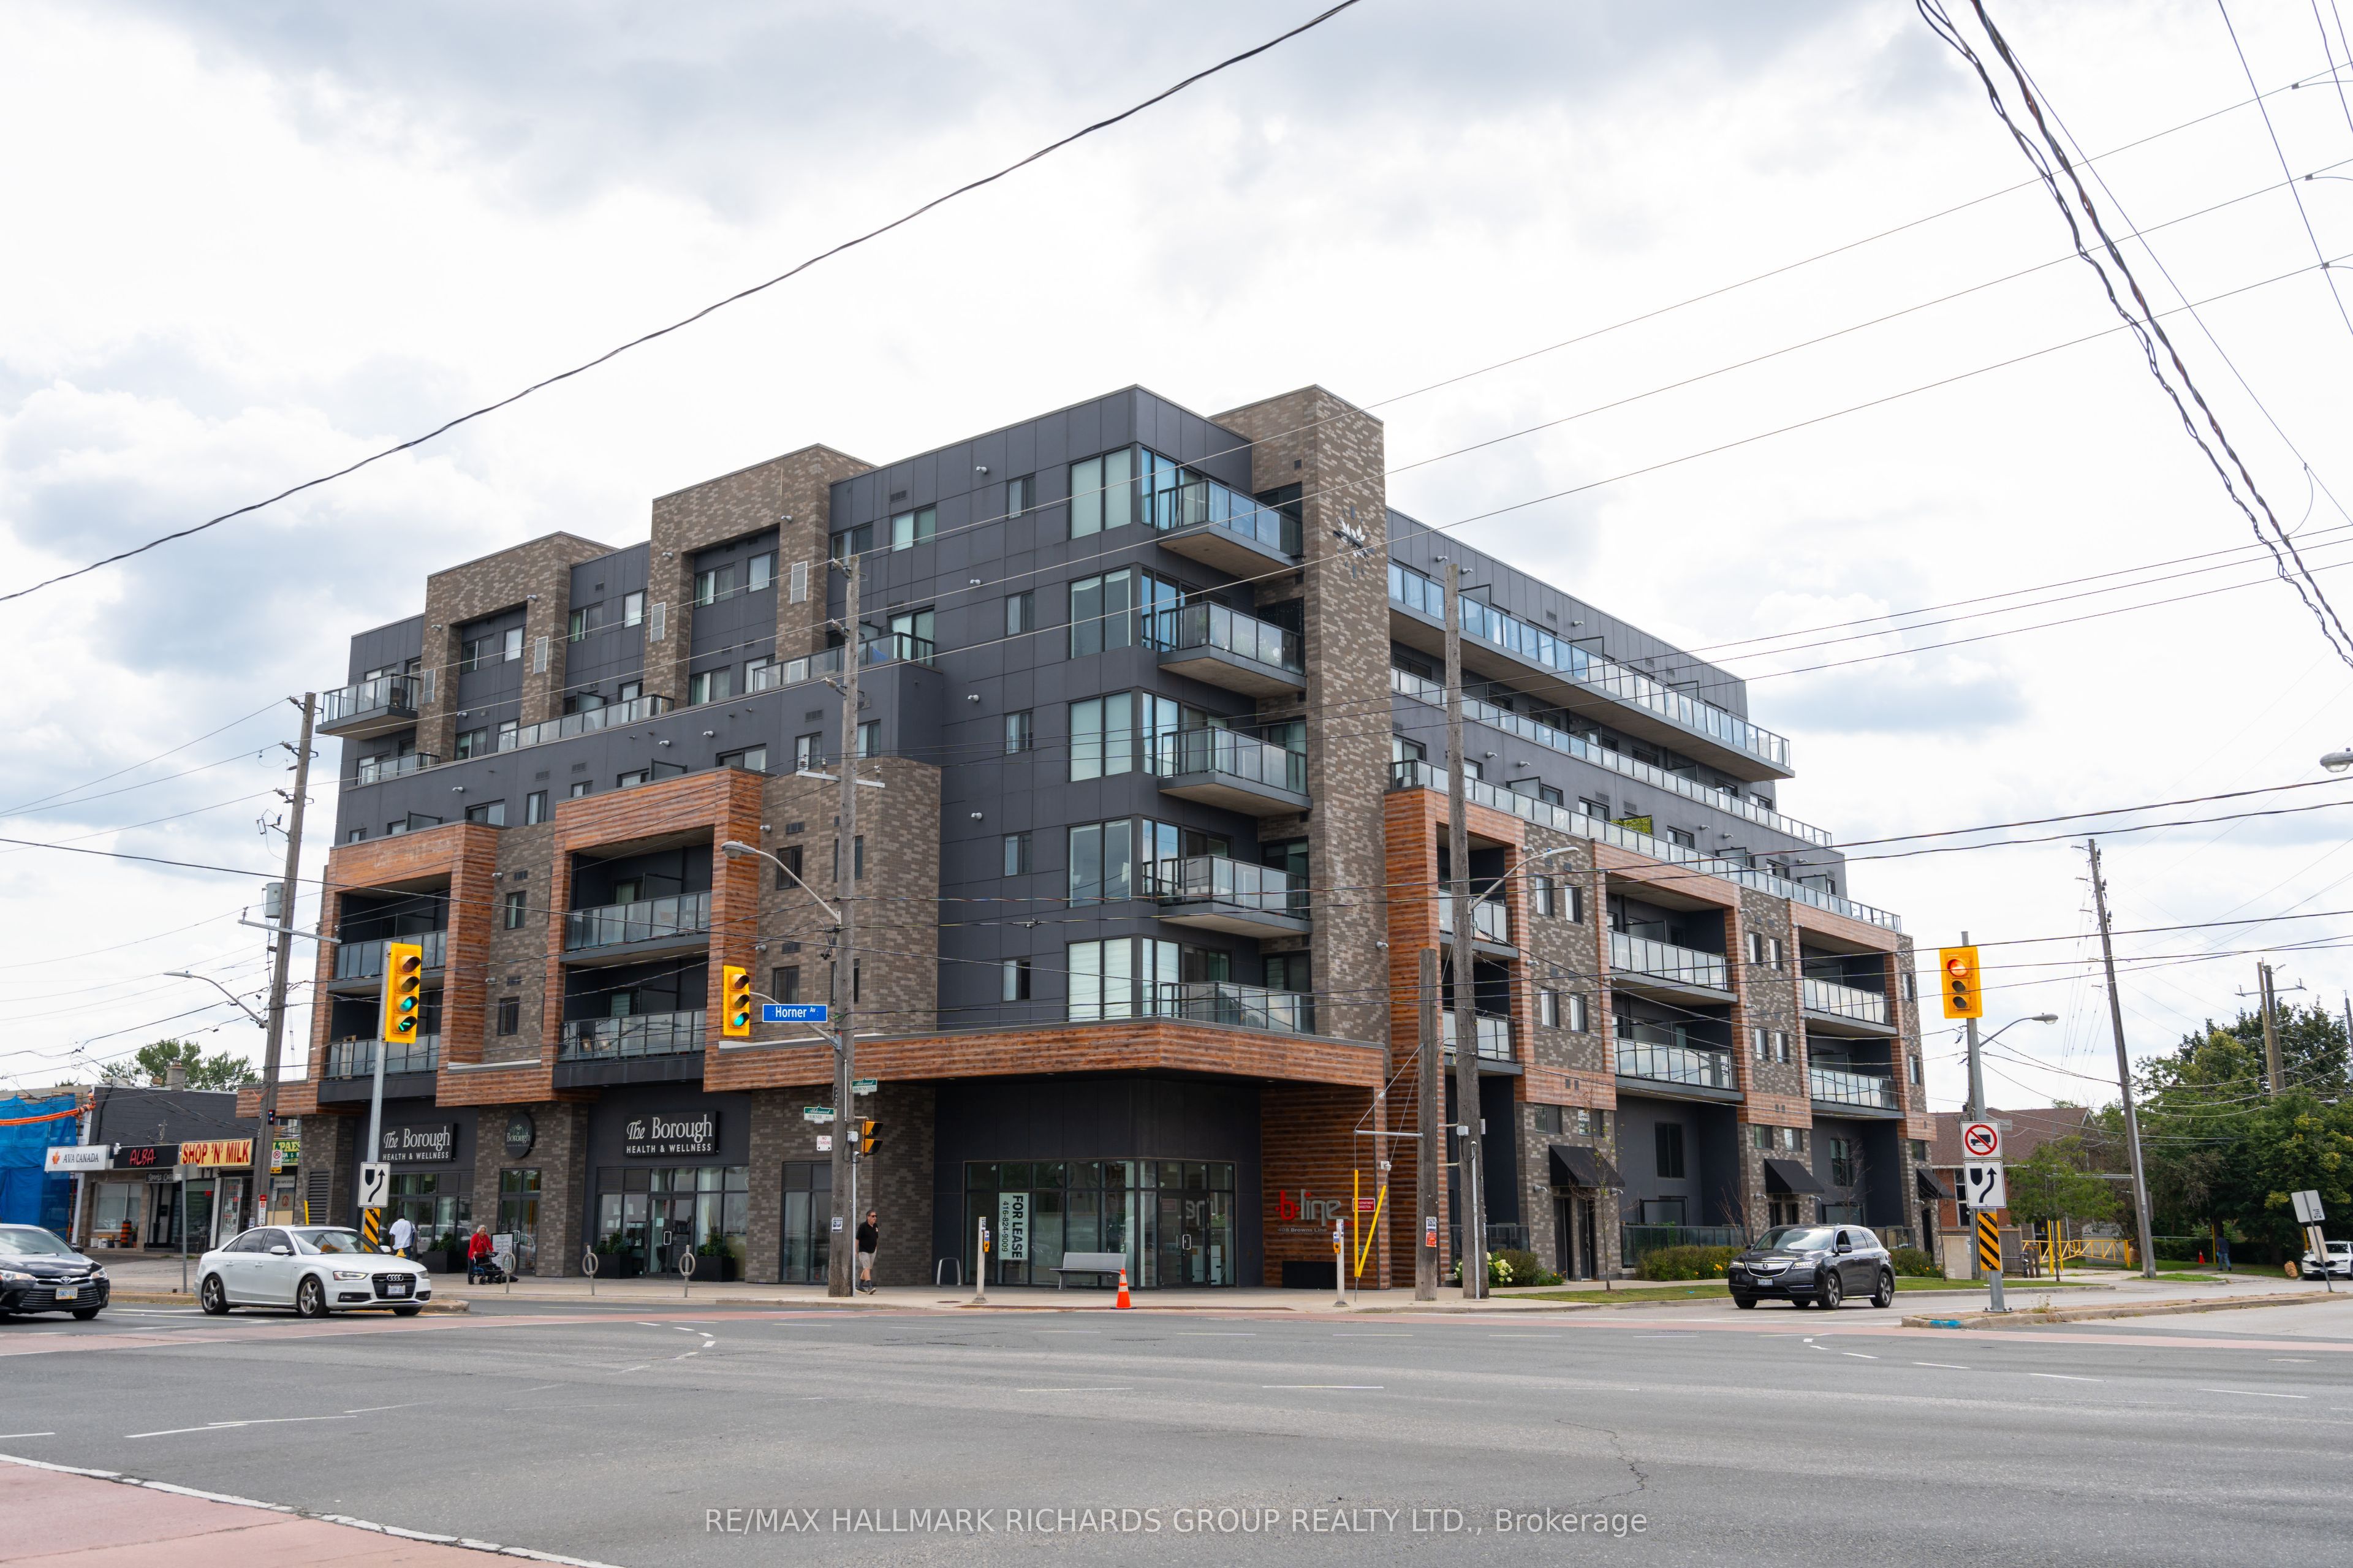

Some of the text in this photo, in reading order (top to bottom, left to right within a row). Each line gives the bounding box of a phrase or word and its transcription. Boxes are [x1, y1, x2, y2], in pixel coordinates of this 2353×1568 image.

[775, 1006, 807, 1018] Horner
[626, 1113, 713, 1143] The Borough
[384, 1125, 450, 1152] The Borough
[507, 1132, 530, 1144] Borough
[129, 1148, 155, 1165] ALBA
[183, 1143, 208, 1164] SHOP
[226, 1142, 250, 1163] MILK
[669, 1143, 711, 1153] WELLNESS
[63, 1153, 99, 1163] AVA CANADA
[1012, 1195, 1024, 1258] FOR LEASE
